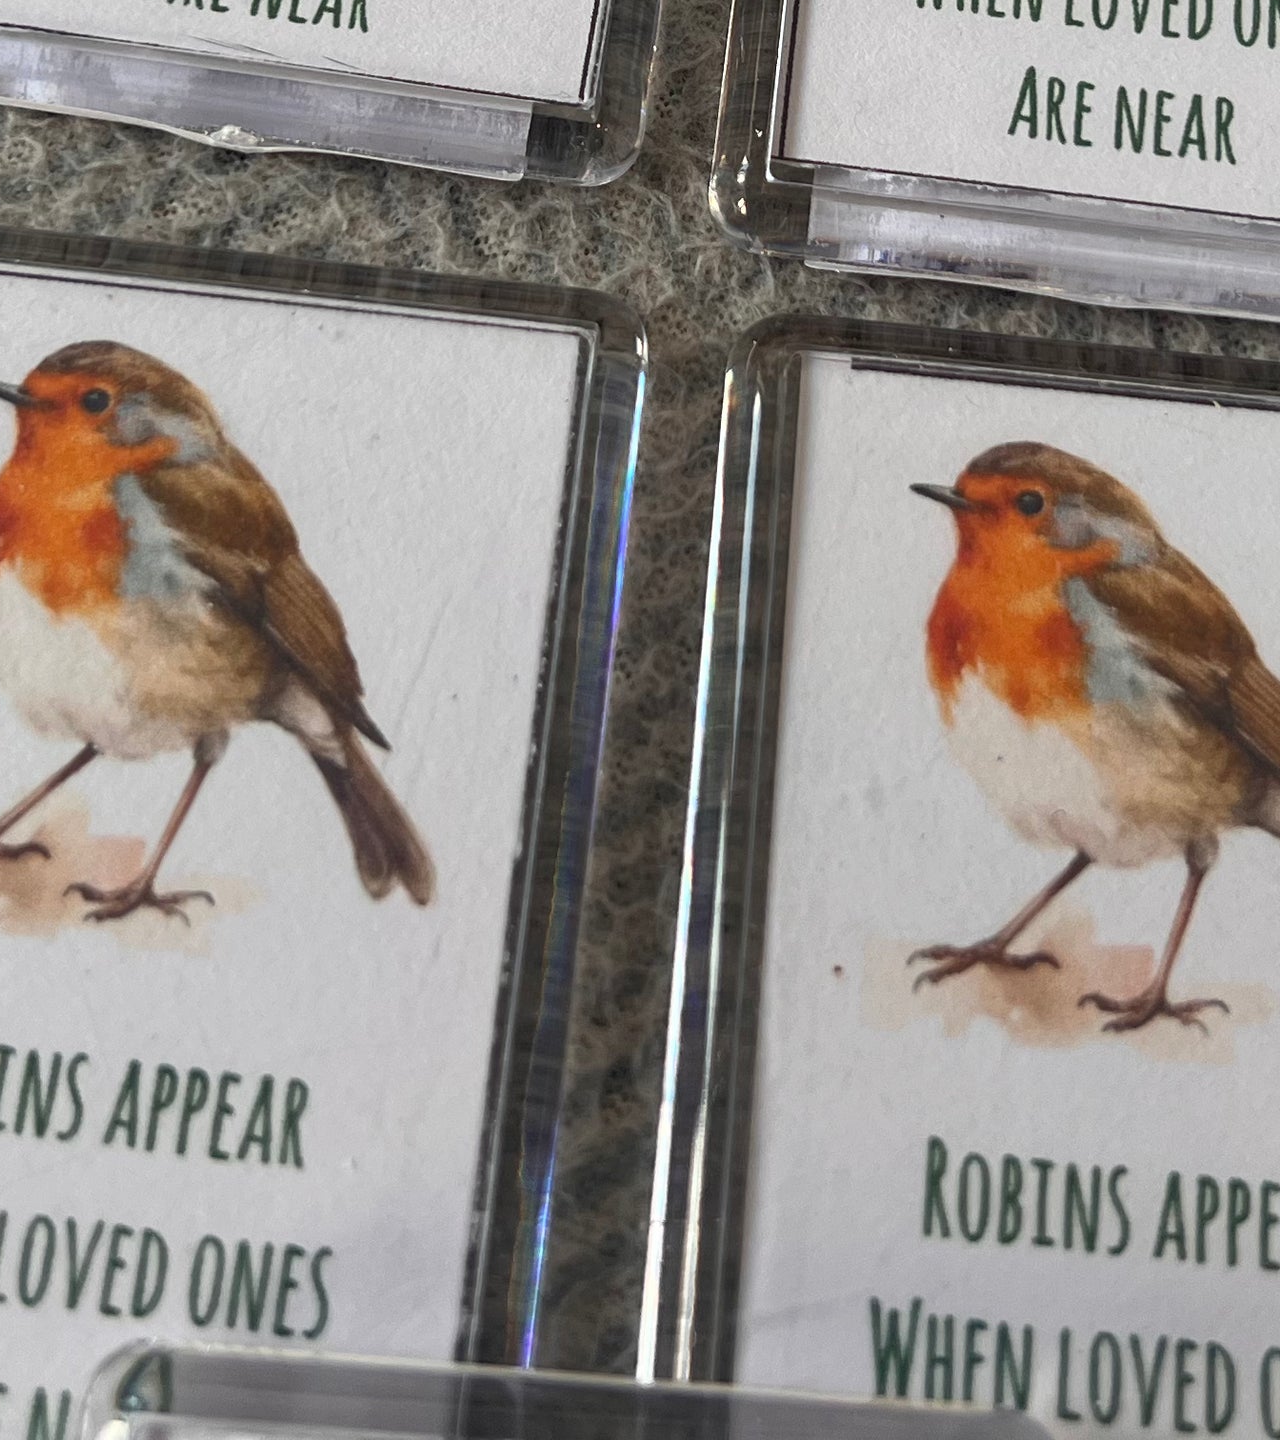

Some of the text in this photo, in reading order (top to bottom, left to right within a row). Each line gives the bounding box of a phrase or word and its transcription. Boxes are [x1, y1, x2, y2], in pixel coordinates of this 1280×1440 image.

[1006, 64, 1238, 167] ARE NEAR
[101, 1057, 311, 1171] APPEAR
[921, 1134, 1133, 1258] ROBINS
[186, 1233, 335, 1343] ONES
[867, 1295, 1034, 1410] WHEN
[1053, 1326, 1239, 1439] LOVED
